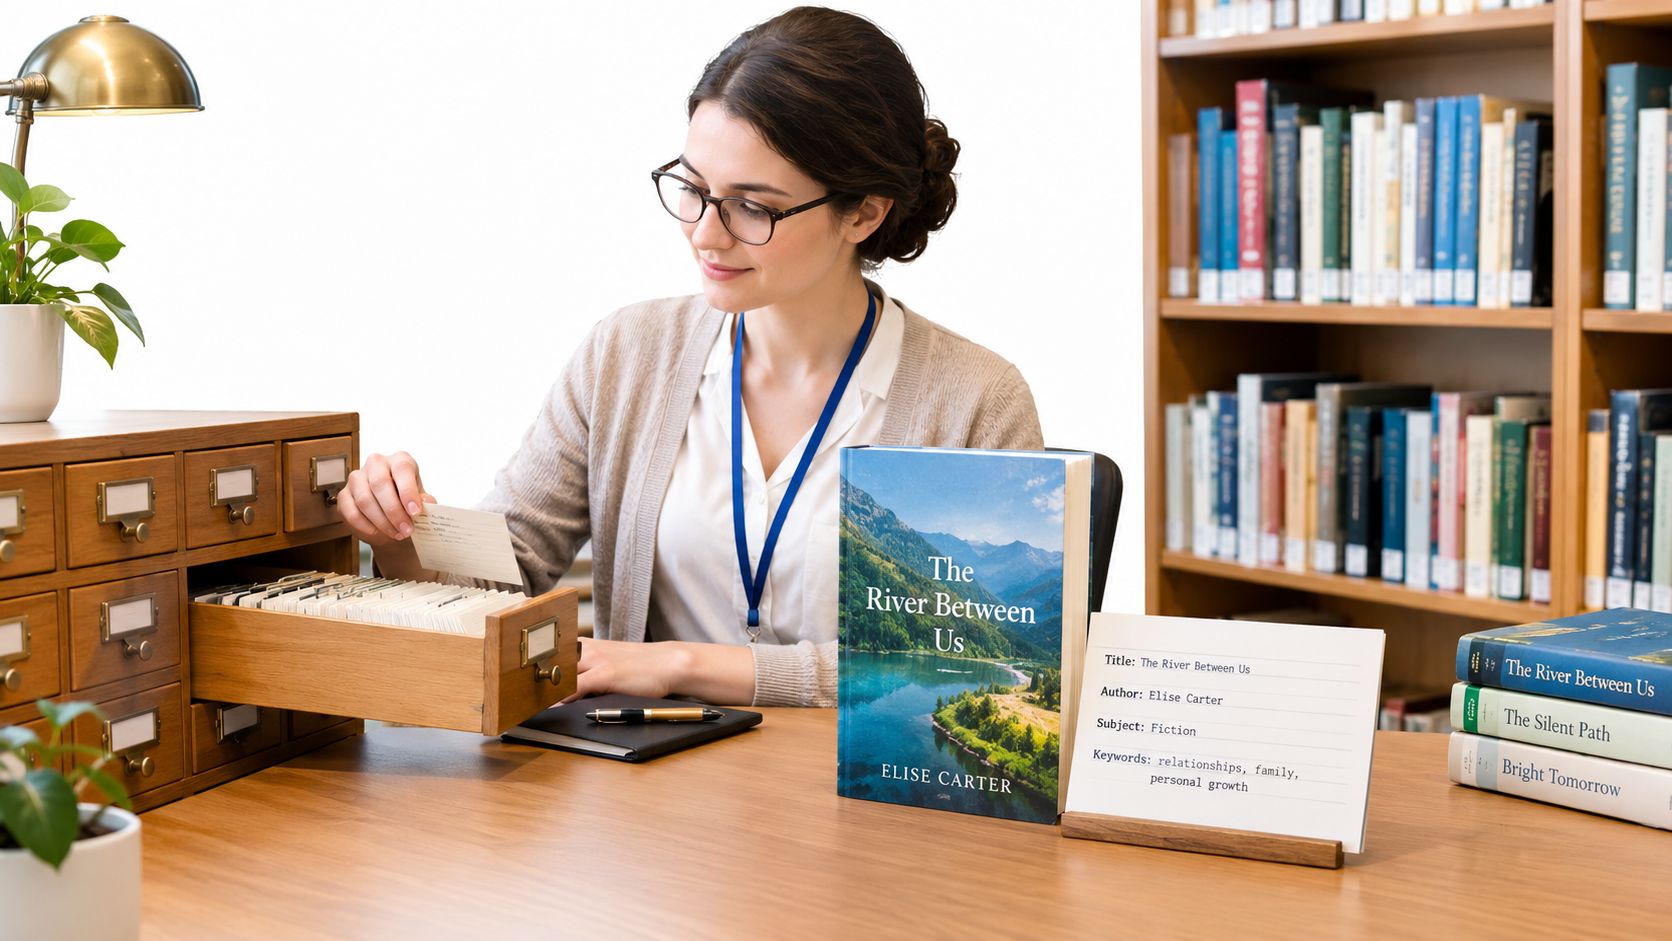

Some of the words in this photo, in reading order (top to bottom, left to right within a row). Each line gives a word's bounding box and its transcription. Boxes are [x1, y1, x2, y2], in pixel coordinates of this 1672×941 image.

[928, 555, 974, 583] The
[866, 587, 928, 615] River
[934, 592, 1036, 624] Between
[934, 628, 965, 653] Us
[1105, 654, 1136, 667] Title:
[1140, 657, 1158, 669] The
[1162, 659, 1191, 671] River
[1194, 661, 1235, 673] Between
[1238, 664, 1251, 675] Us
[1505, 658, 1532, 678] The
[1535, 663, 1572, 684] River
[1575, 669, 1633, 694] Between
[1637, 679, 1655, 698] Us
[1100, 686, 1143, 700] Author:
[1149, 690, 1181, 703] Elise
[1186, 693, 1223, 706] Carter
[1096, 718, 1145, 734] Subject:
[1151, 723, 1196, 737] Fiction
[1504, 708, 1530, 728] The
[1534, 714, 1574, 735] Silent
[1579, 721, 1610, 742] Path
[881, 763, 931, 784] ELISE
[938, 770, 1012, 794] CARTER
[1093, 749, 1151, 766] Keywords:
[1158, 756, 1247, 775] relationships,
[1255, 765, 1299, 780] family,
[1502, 758, 1544, 783] Bright
[1548, 768, 1621, 797] Tomorrow
[1150, 773, 1202, 788] personal
[1208, 778, 1249, 793] growth
